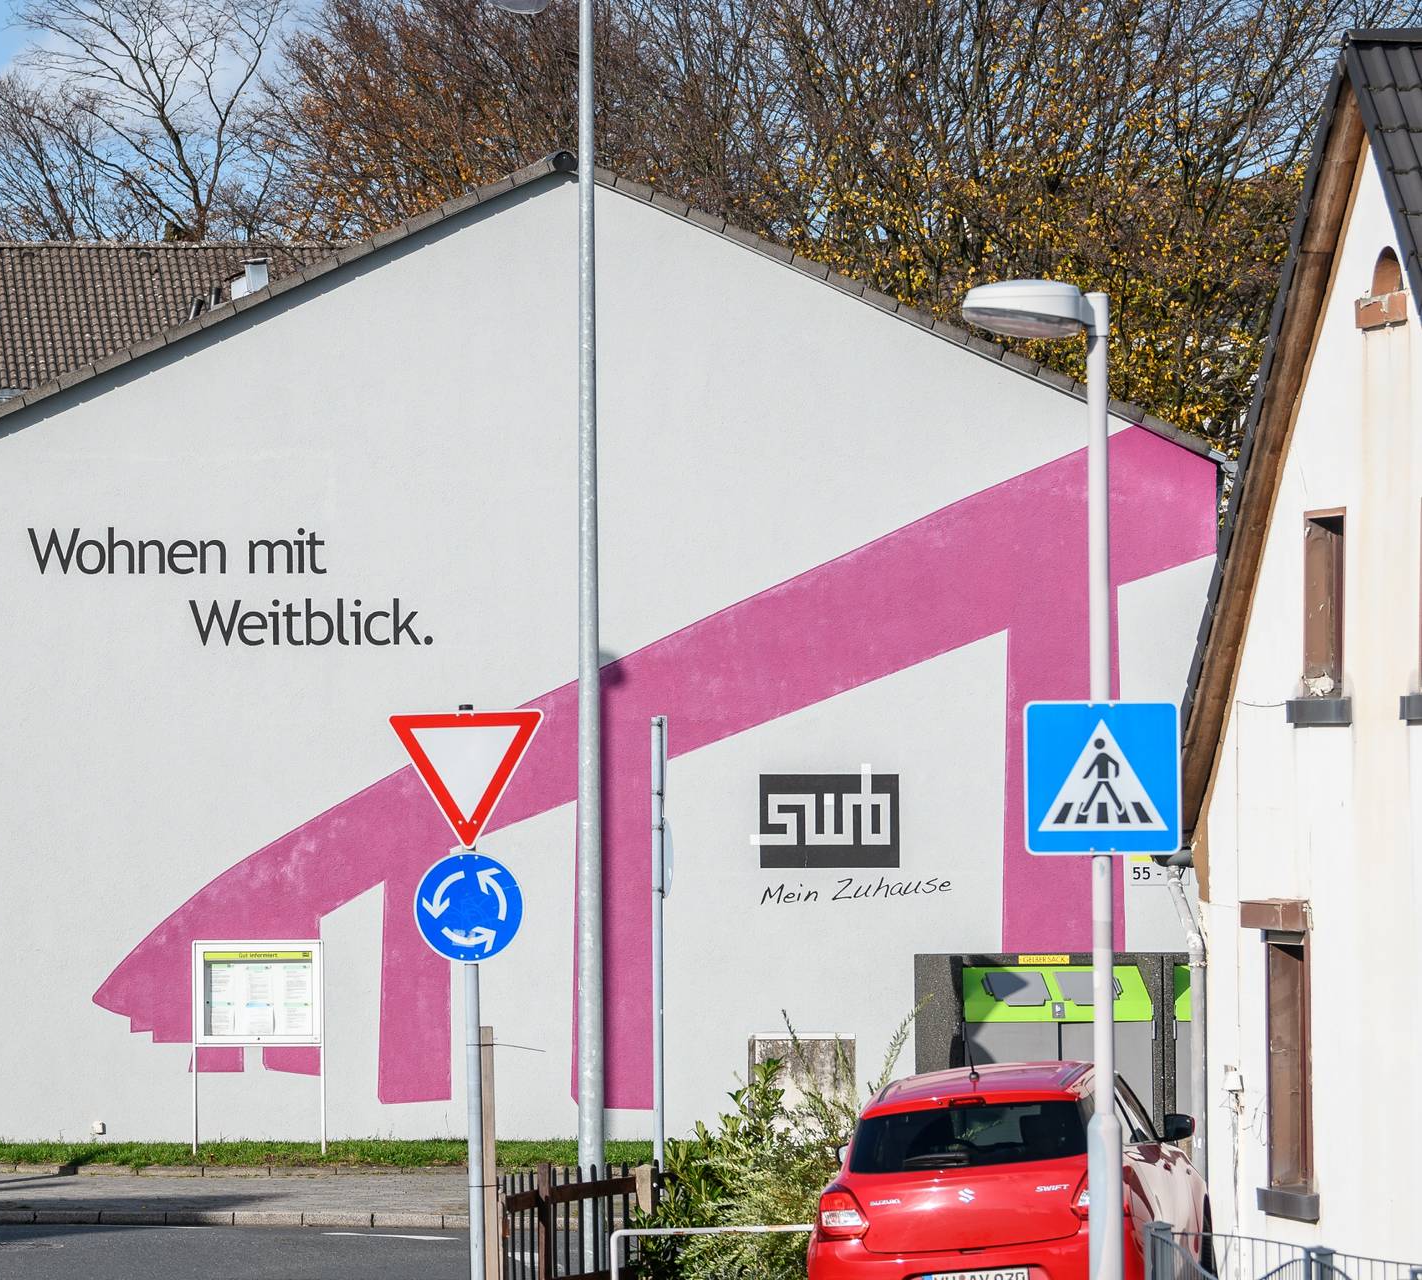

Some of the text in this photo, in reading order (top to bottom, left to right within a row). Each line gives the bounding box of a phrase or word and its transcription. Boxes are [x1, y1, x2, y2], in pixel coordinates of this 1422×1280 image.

[27, 527, 327, 575] Wohnen mit
[188, 598, 434, 647] Weitblick.
[750, 763, 891, 846] swb
[760, 876, 953, 905] Mein Zuhause
[1132, 866, 1151, 880] 55
[1035, 1183, 1070, 1193] SWIFT
